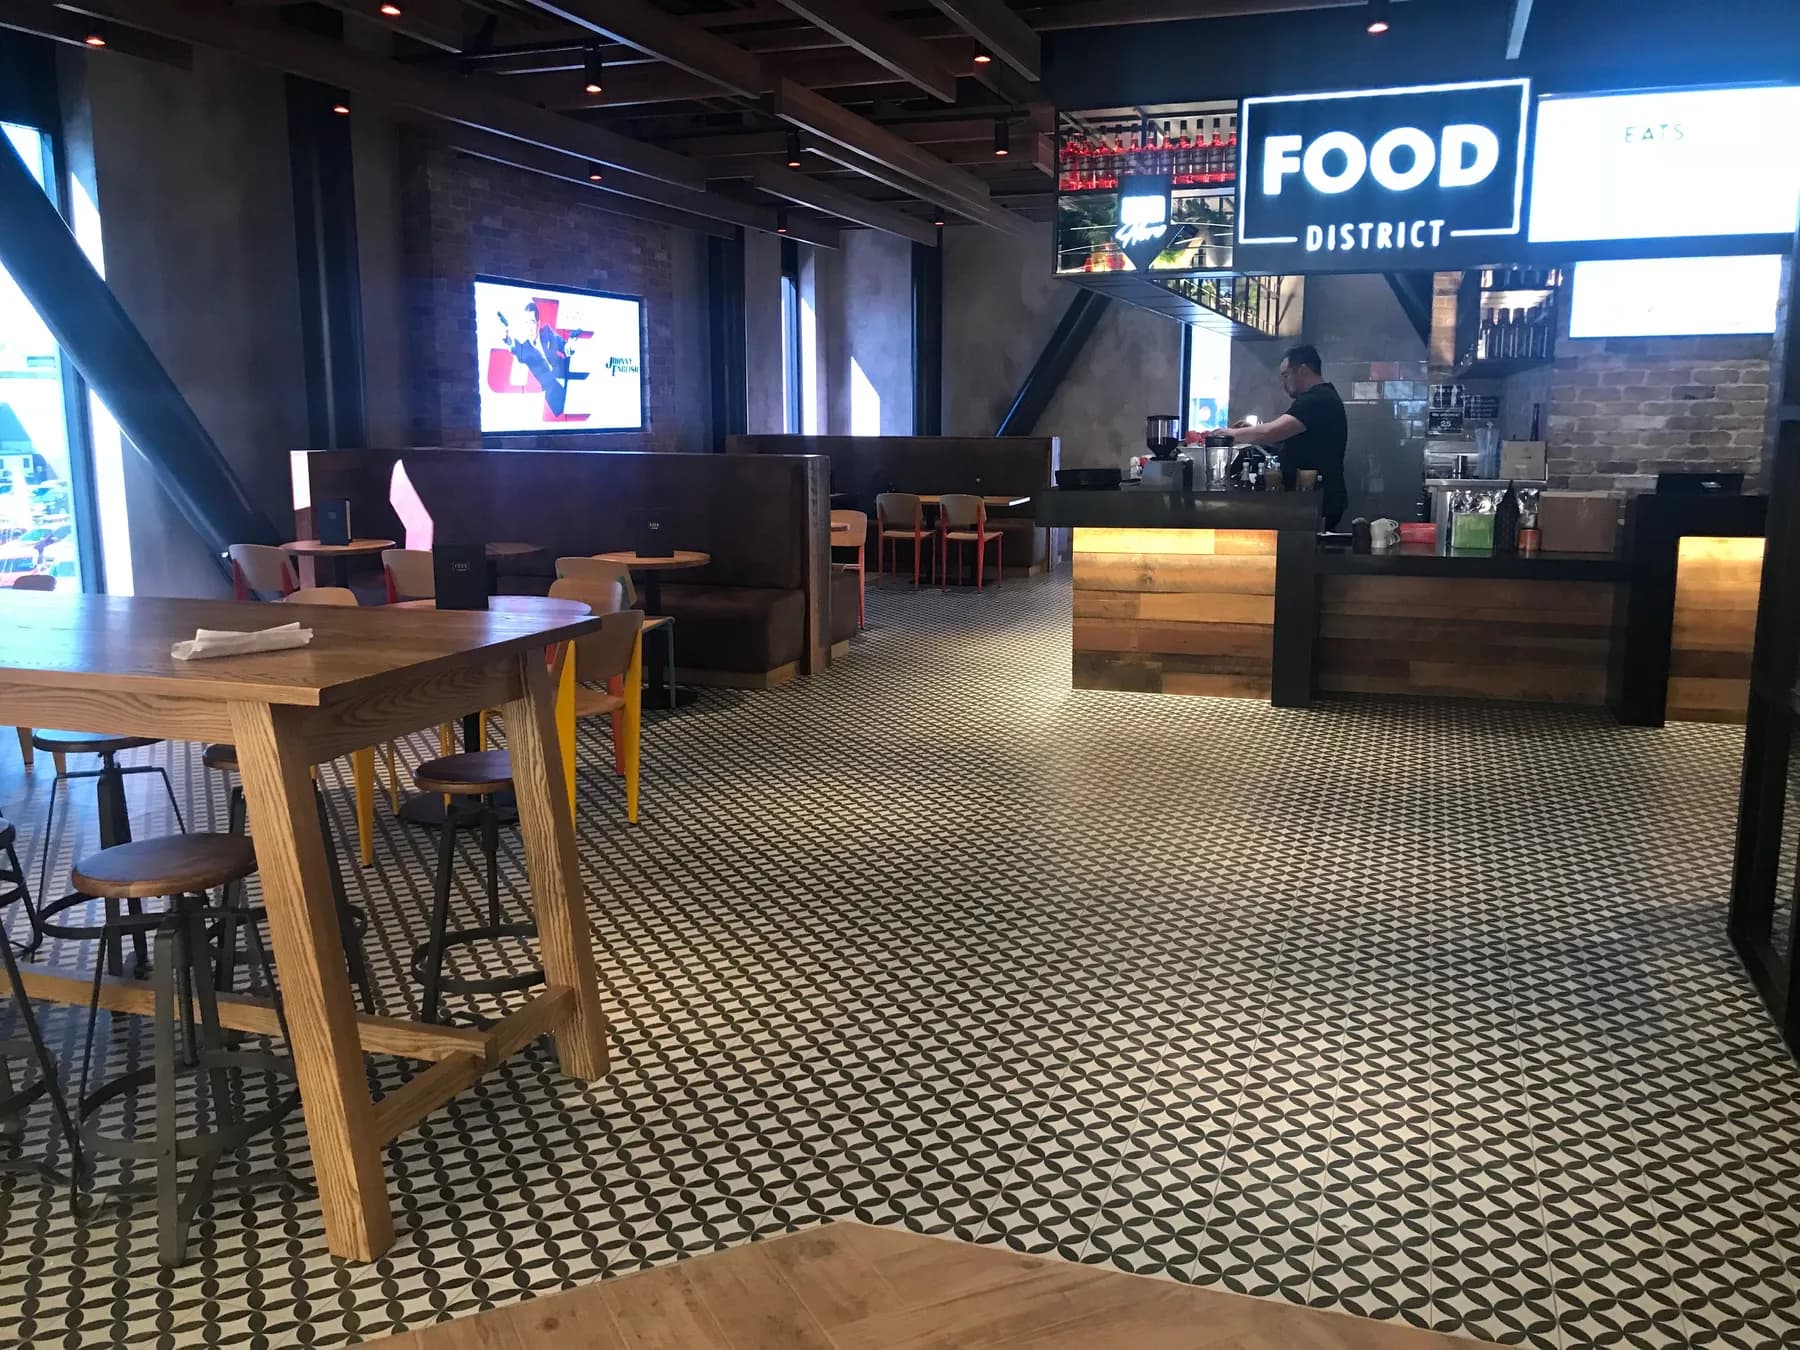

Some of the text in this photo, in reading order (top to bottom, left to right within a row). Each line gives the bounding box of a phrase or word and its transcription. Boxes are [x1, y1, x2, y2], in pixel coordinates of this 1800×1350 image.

[1624, 122, 1685, 144] EATS
[1263, 124, 1499, 195] FOOD
[1305, 219, 1446, 252] DISTRICT
